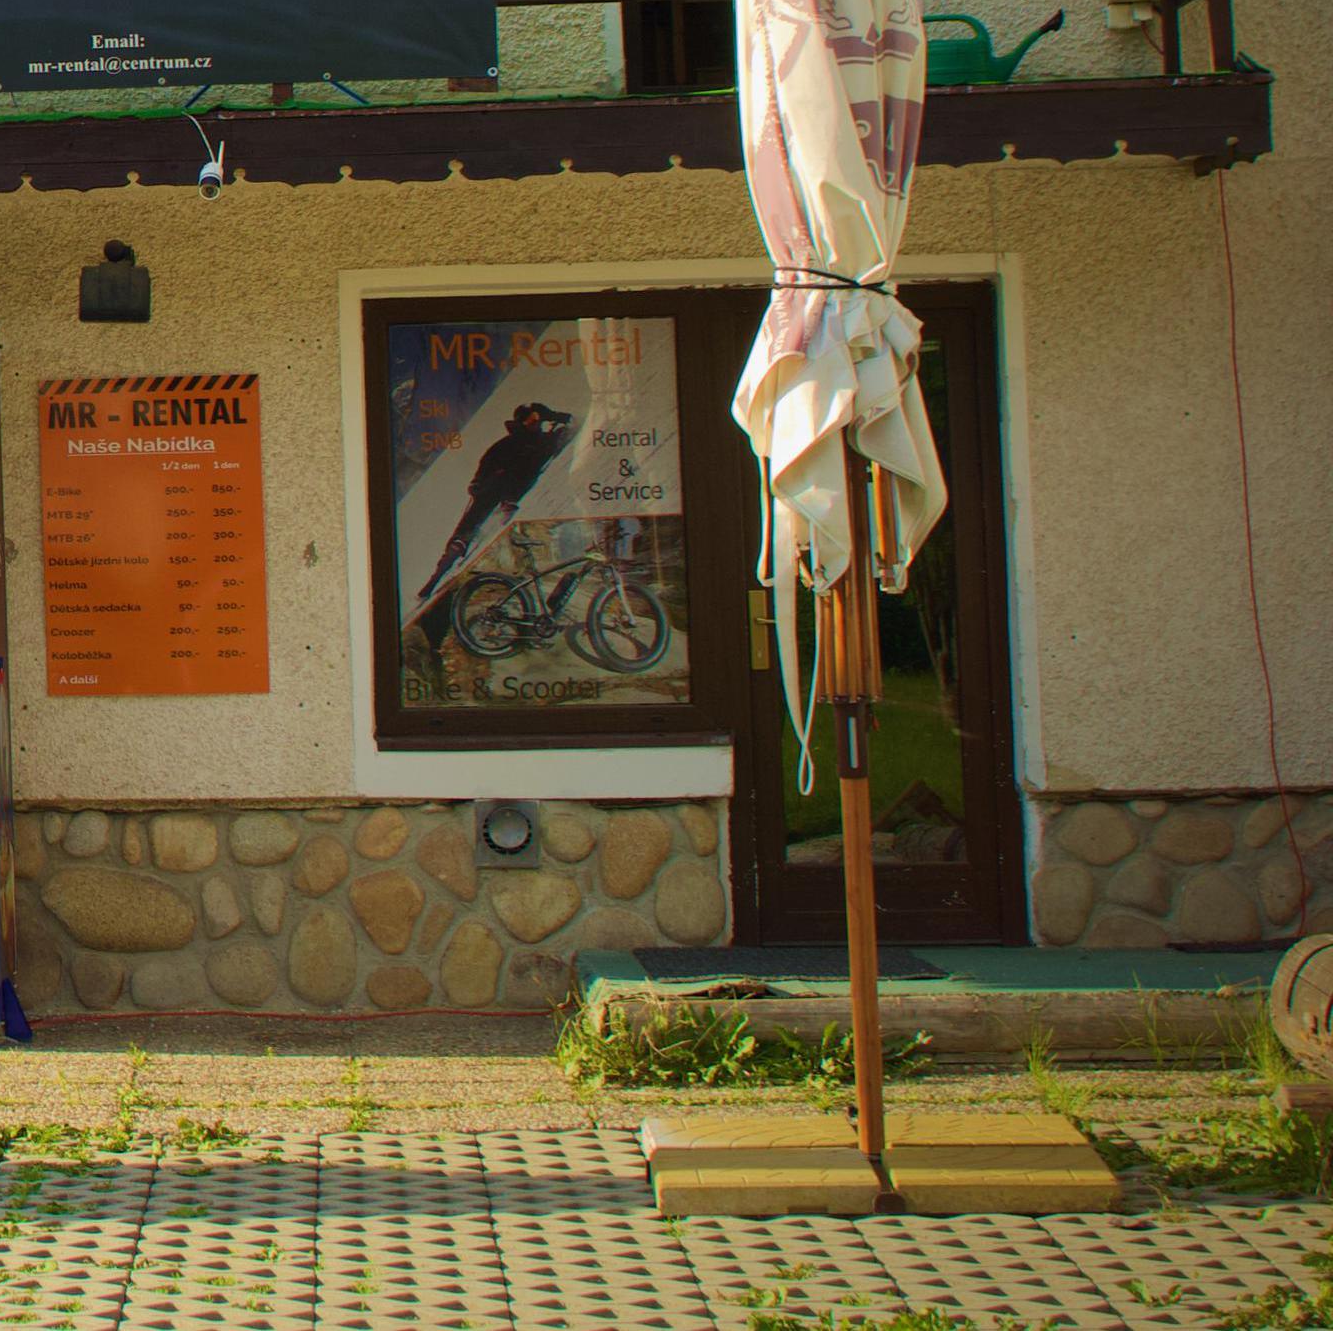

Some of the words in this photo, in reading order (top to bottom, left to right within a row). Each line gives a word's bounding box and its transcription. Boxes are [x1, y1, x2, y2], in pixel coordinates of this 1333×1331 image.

[91, 34, 146, 49] Email:
[28, 55, 213, 74] mr-rental@centrum.cz
[48, 402, 97, 429] MR
[132, 398, 248, 426] RENTAL
[592, 428, 657, 448] Rental
[68, 439, 121, 454] Naše
[162, 461, 180, 470] 1/2
[181, 462, 201, 470] den
[221, 461, 240, 469] den
[619, 458, 634, 477] &
[588, 482, 663, 502] Service
[47, 511, 73, 520] MTB
[48, 534, 74, 543] MTB
[49, 581, 88, 590] Helma
[93, 603, 141, 613] sedačka
[59, 676, 68, 684] A
[404, 678, 462, 701] Bike
[471, 678, 493, 700] &
[502, 676, 606, 700] Scooter
